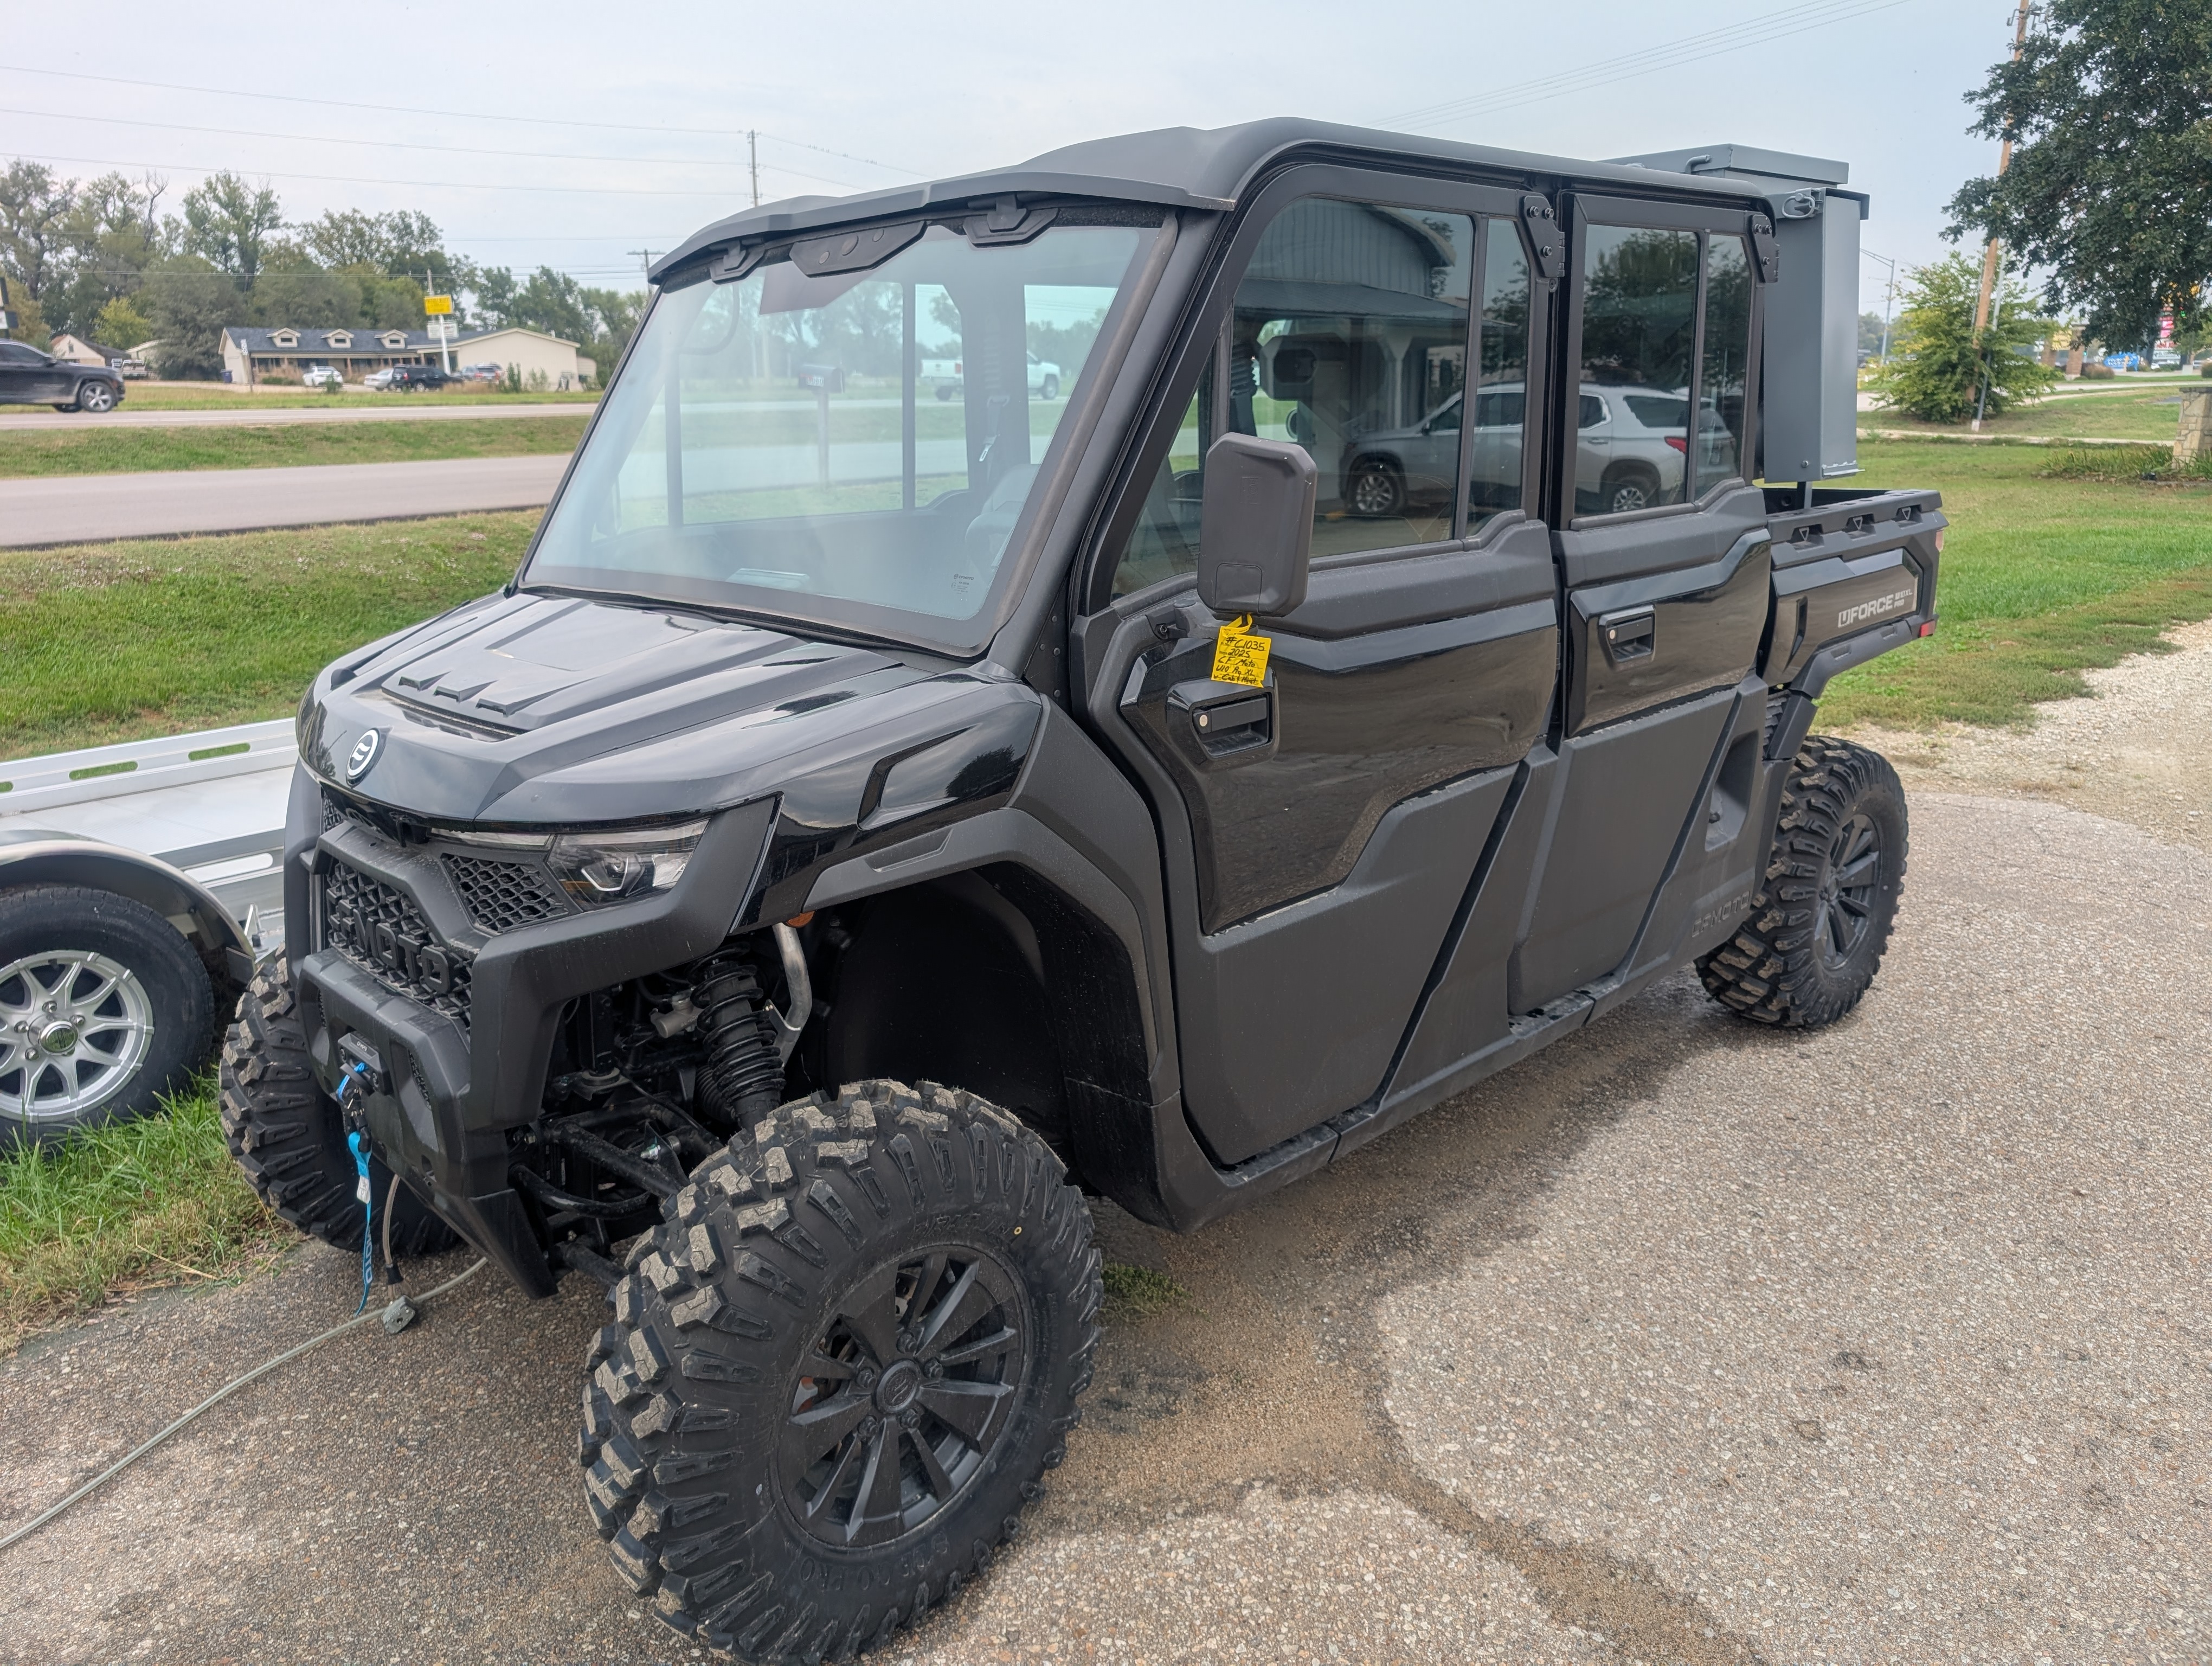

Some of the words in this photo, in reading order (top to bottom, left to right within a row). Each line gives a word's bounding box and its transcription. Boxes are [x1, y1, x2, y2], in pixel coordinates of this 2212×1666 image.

[1894, 599, 1905, 608] PRO
[1228, 648, 1251, 658] 2025
[1245, 669, 1255, 677] XL
[1692, 890, 1750, 938] CFMOTO
[326, 888, 450, 995] CFMOTO
